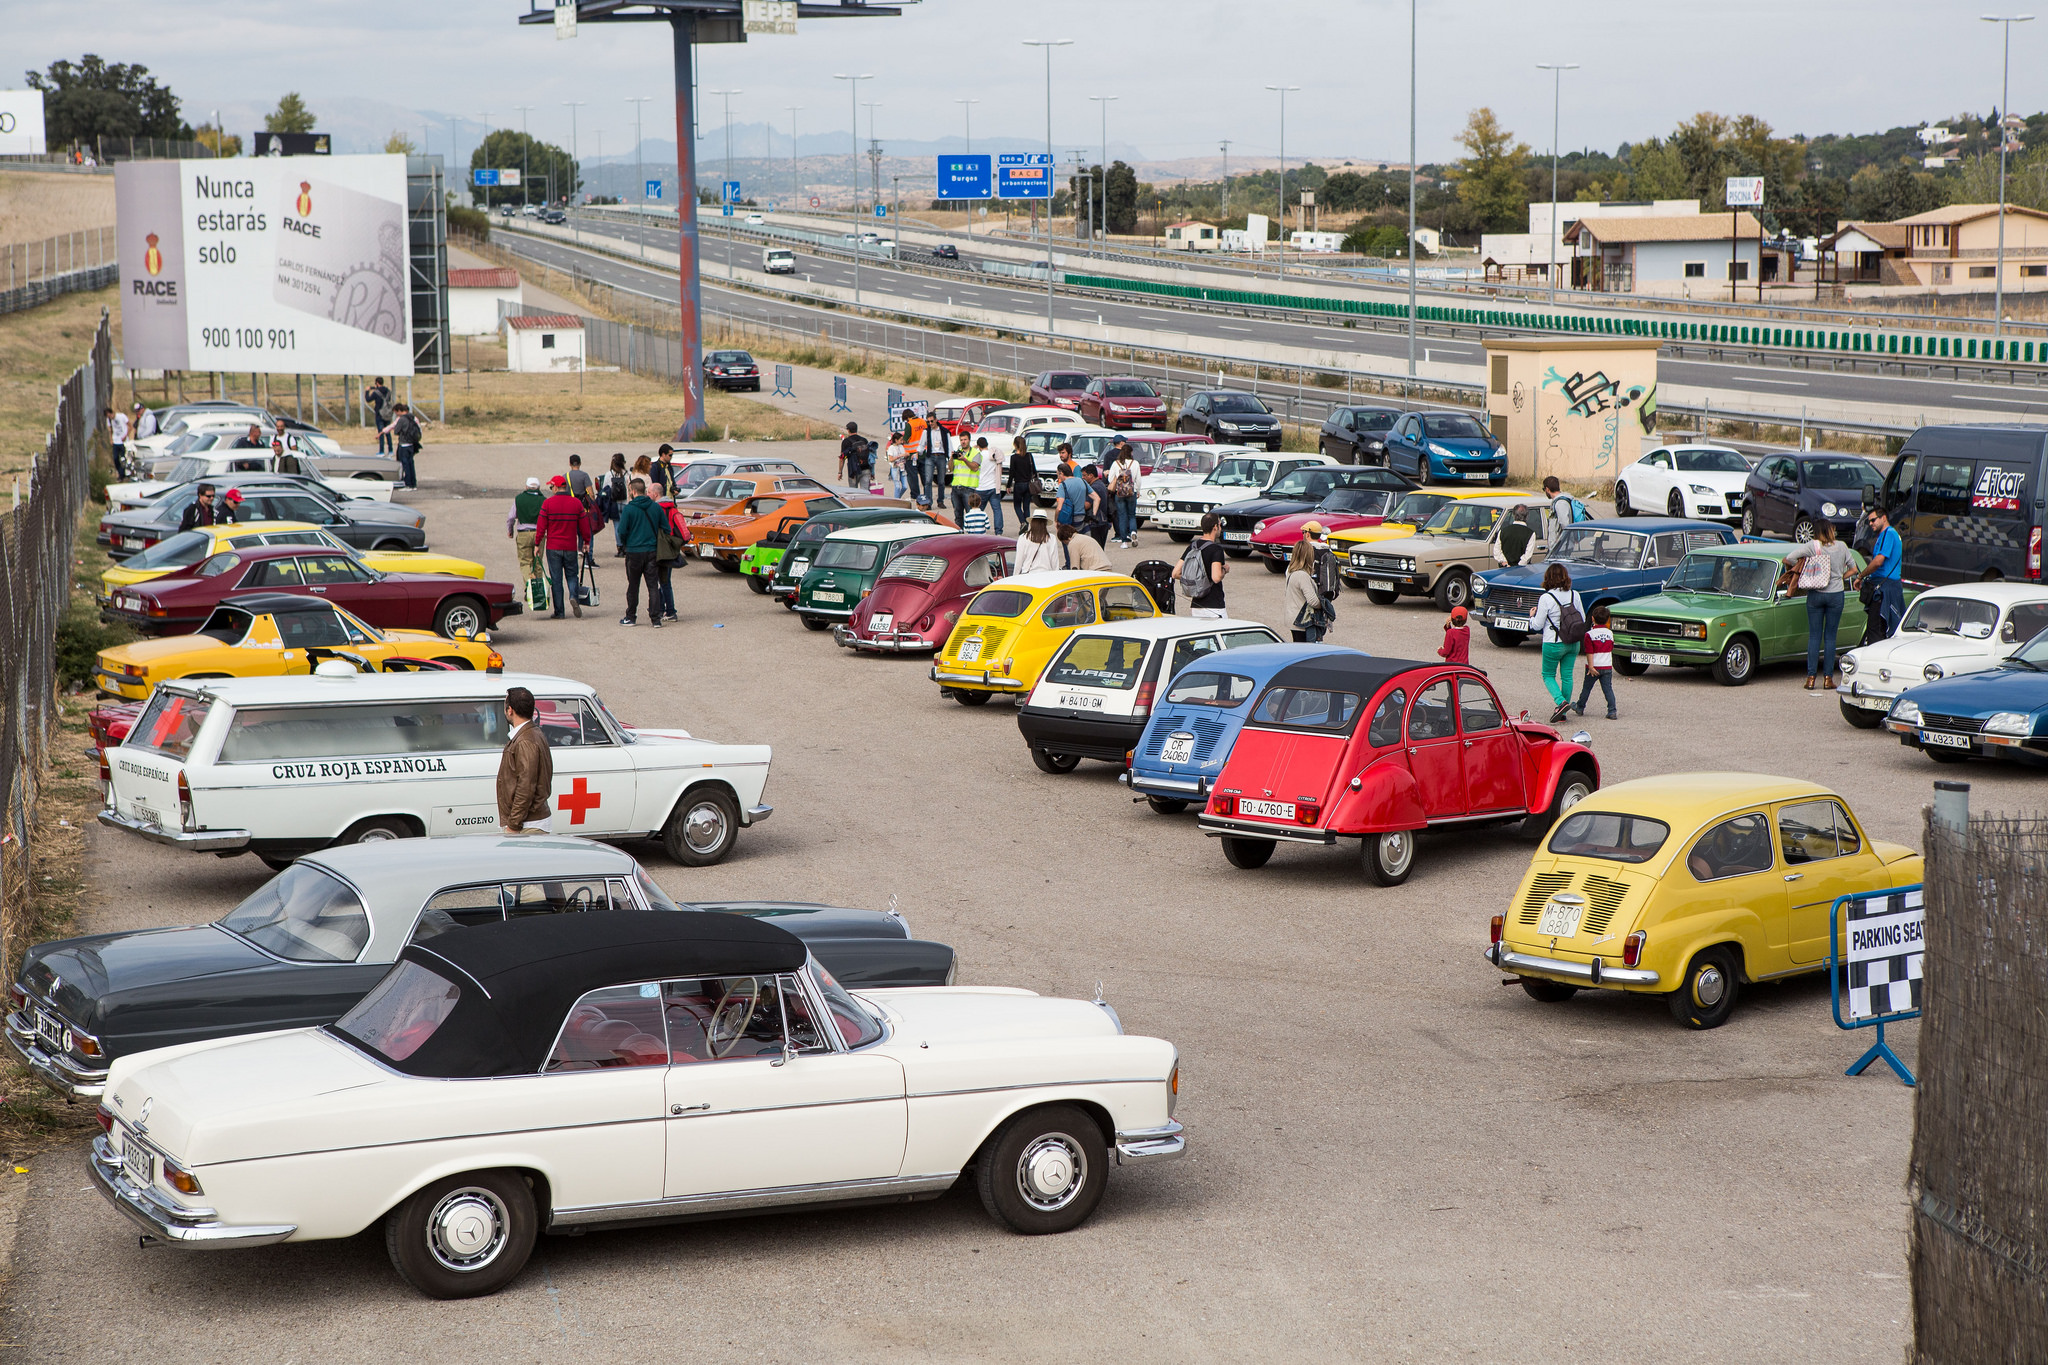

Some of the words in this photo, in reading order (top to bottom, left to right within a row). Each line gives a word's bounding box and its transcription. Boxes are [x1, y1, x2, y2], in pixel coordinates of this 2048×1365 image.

[196, 175, 254, 198] Nunca
[951, 175, 978, 183] Burgos
[1729, 191, 1752, 202] PISCINA
[197, 205, 267, 231] estarás
[283, 217, 322, 239] RACE
[199, 240, 236, 264] solo
[278, 257, 304, 274] CARLOS
[305, 264, 346, 286] FERNÁNDEZ
[133, 280, 177, 296] RACE
[277, 273, 290, 287] NM
[292, 277, 321, 296] 3012594
[202, 327, 230, 348] 900
[236, 328, 263, 349] 100
[268, 329, 295, 350] 901
[1060, 668, 1127, 679] TURBO
[1171, 740, 1184, 750] CR
[1923, 732, 1930, 743] M
[1933, 733, 1954, 746] 4923
[1956, 736, 1969, 747] CM
[1162, 749, 1189, 762] 24060
[118, 759, 131, 773] CRUZ
[131, 763, 142, 777] ROJA
[142, 767, 169, 782] ESPAÑOLA
[272, 764, 316, 779] CRUZ
[319, 762, 362, 780] ROJA
[365, 757, 447, 775] ESPAÑOLA
[455, 815, 494, 826] OXIGENO
[1545, 905, 1581, 922] M-870
[1546, 919, 1569, 935] 880
[1853, 924, 1901, 951] PARKING
